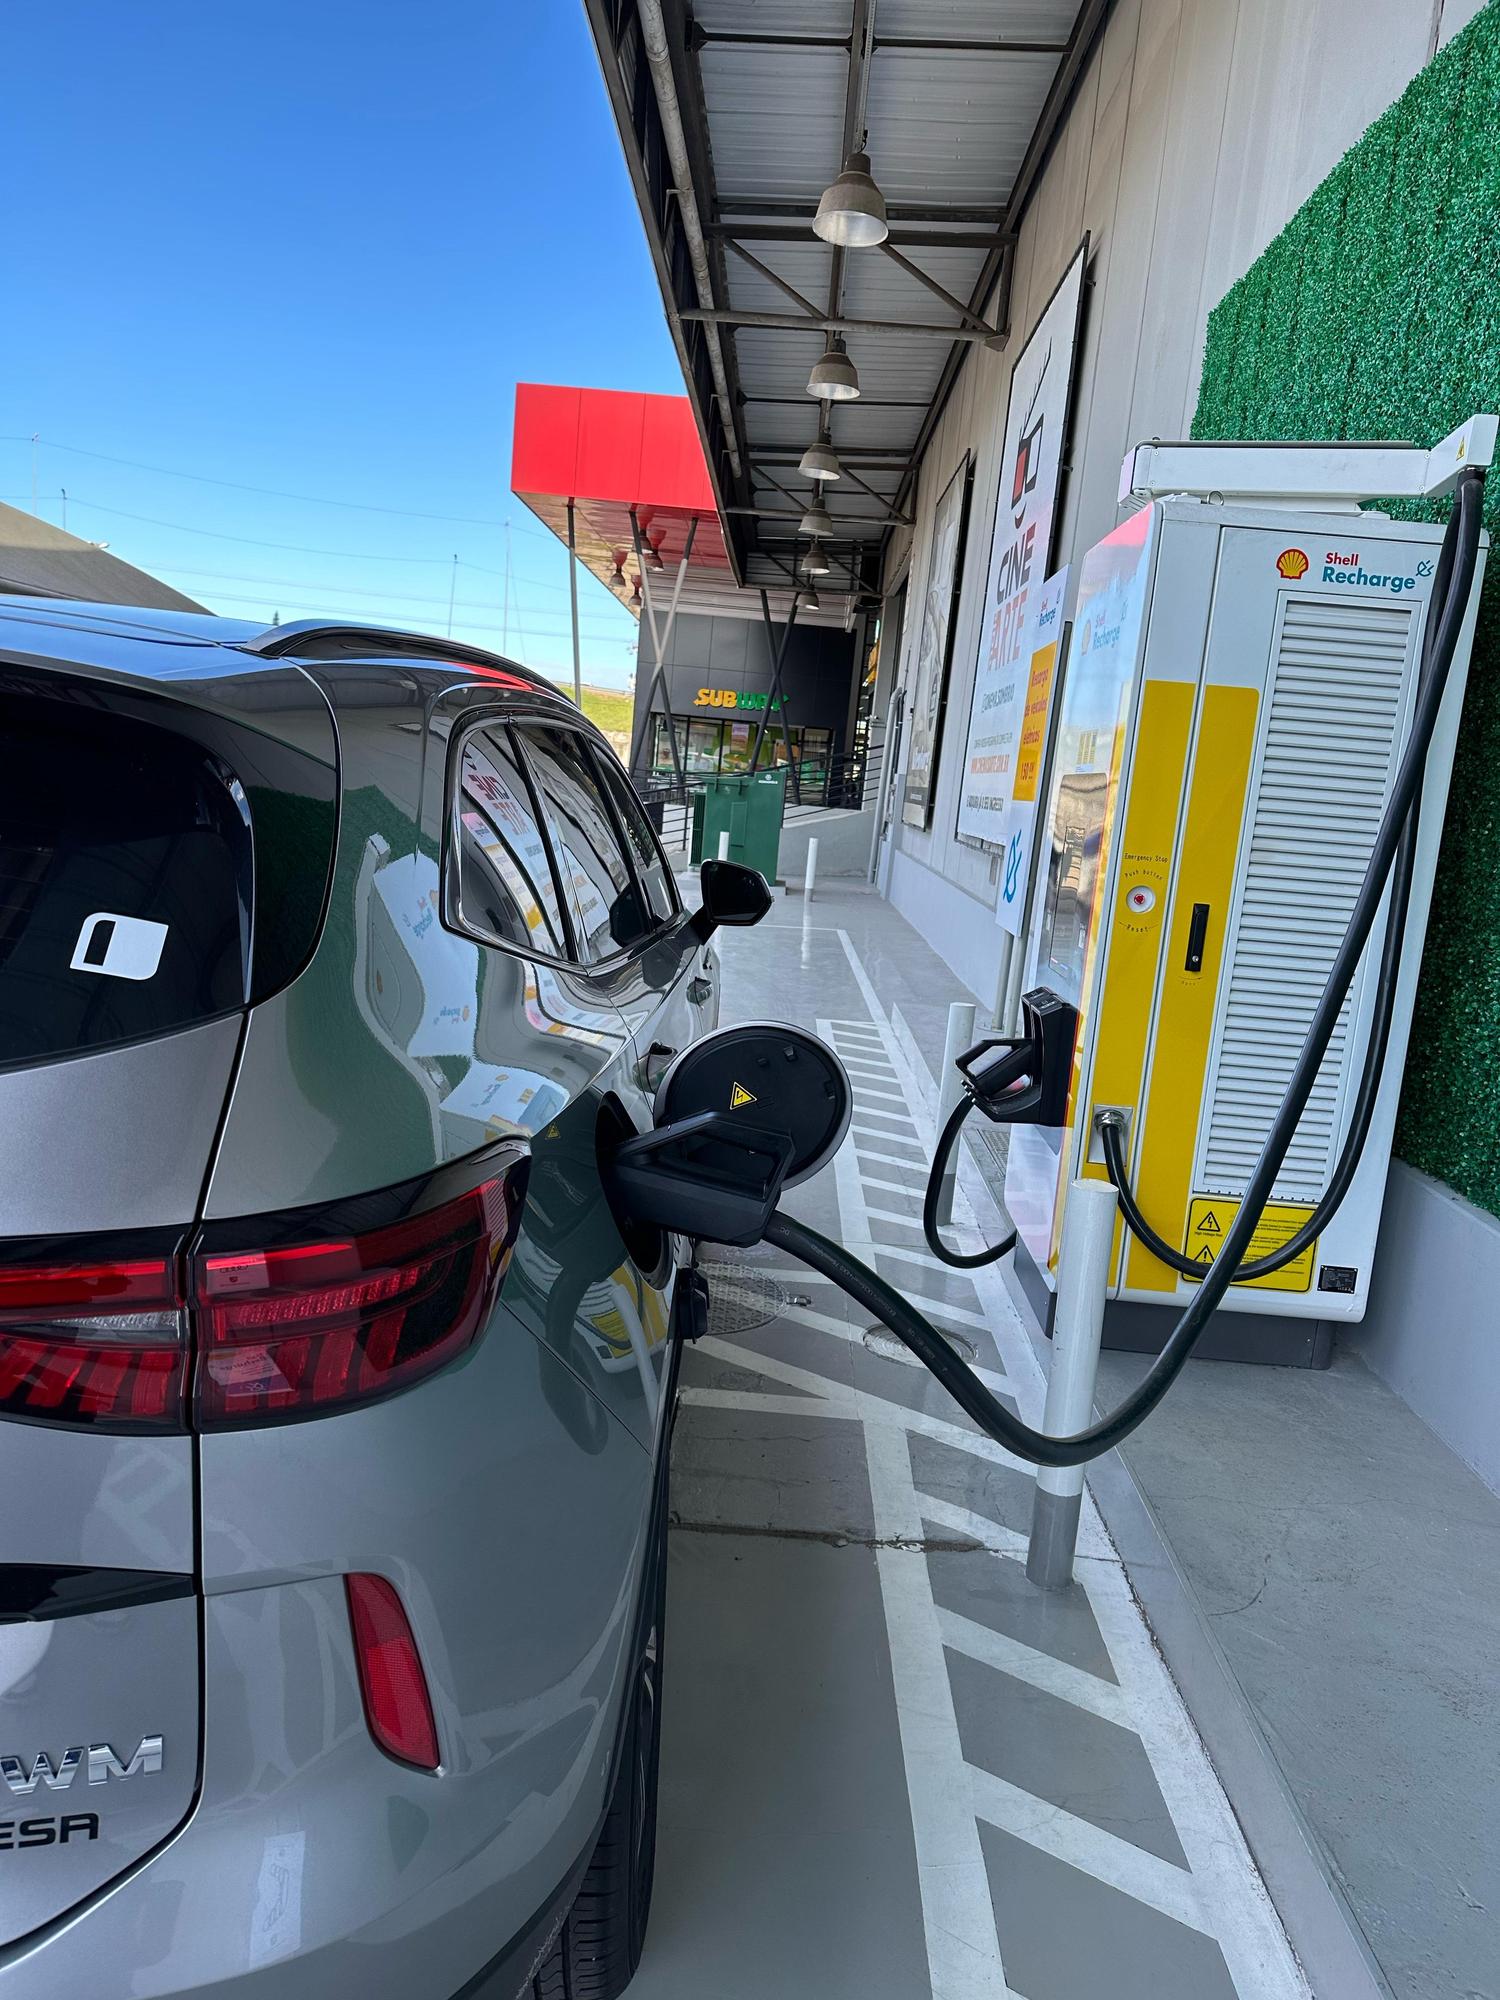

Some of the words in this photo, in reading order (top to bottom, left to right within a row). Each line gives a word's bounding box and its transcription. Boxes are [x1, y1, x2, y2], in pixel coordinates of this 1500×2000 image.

[997, 522, 1036, 605] CINE
[1325, 552, 1359, 566] Shell
[1322, 566, 1416, 593] Recharge
[987, 588, 1028, 672] ARTE
[1124, 853, 1152, 862] Emergency
[1155, 855, 1168, 863] Stop
